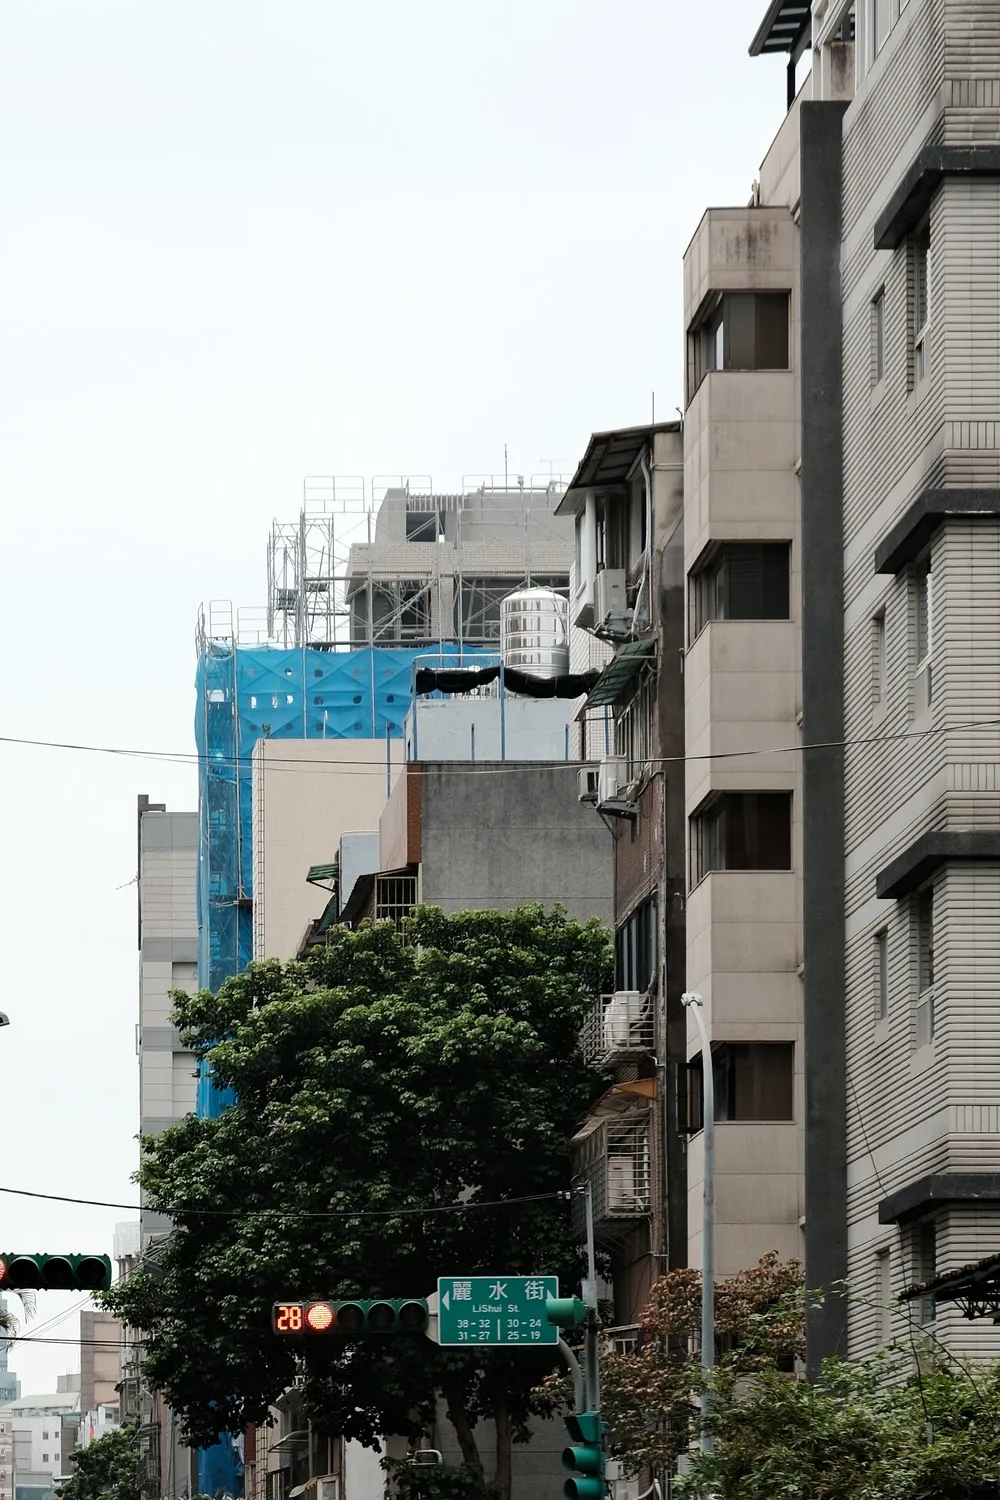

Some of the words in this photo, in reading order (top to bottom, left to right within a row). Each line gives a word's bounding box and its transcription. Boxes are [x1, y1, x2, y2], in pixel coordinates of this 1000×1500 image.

[452, 1280, 545, 1301] 麗水街
[277, 1306, 302, 1331] 28
[472, 1304, 502, 1313] LiShui
